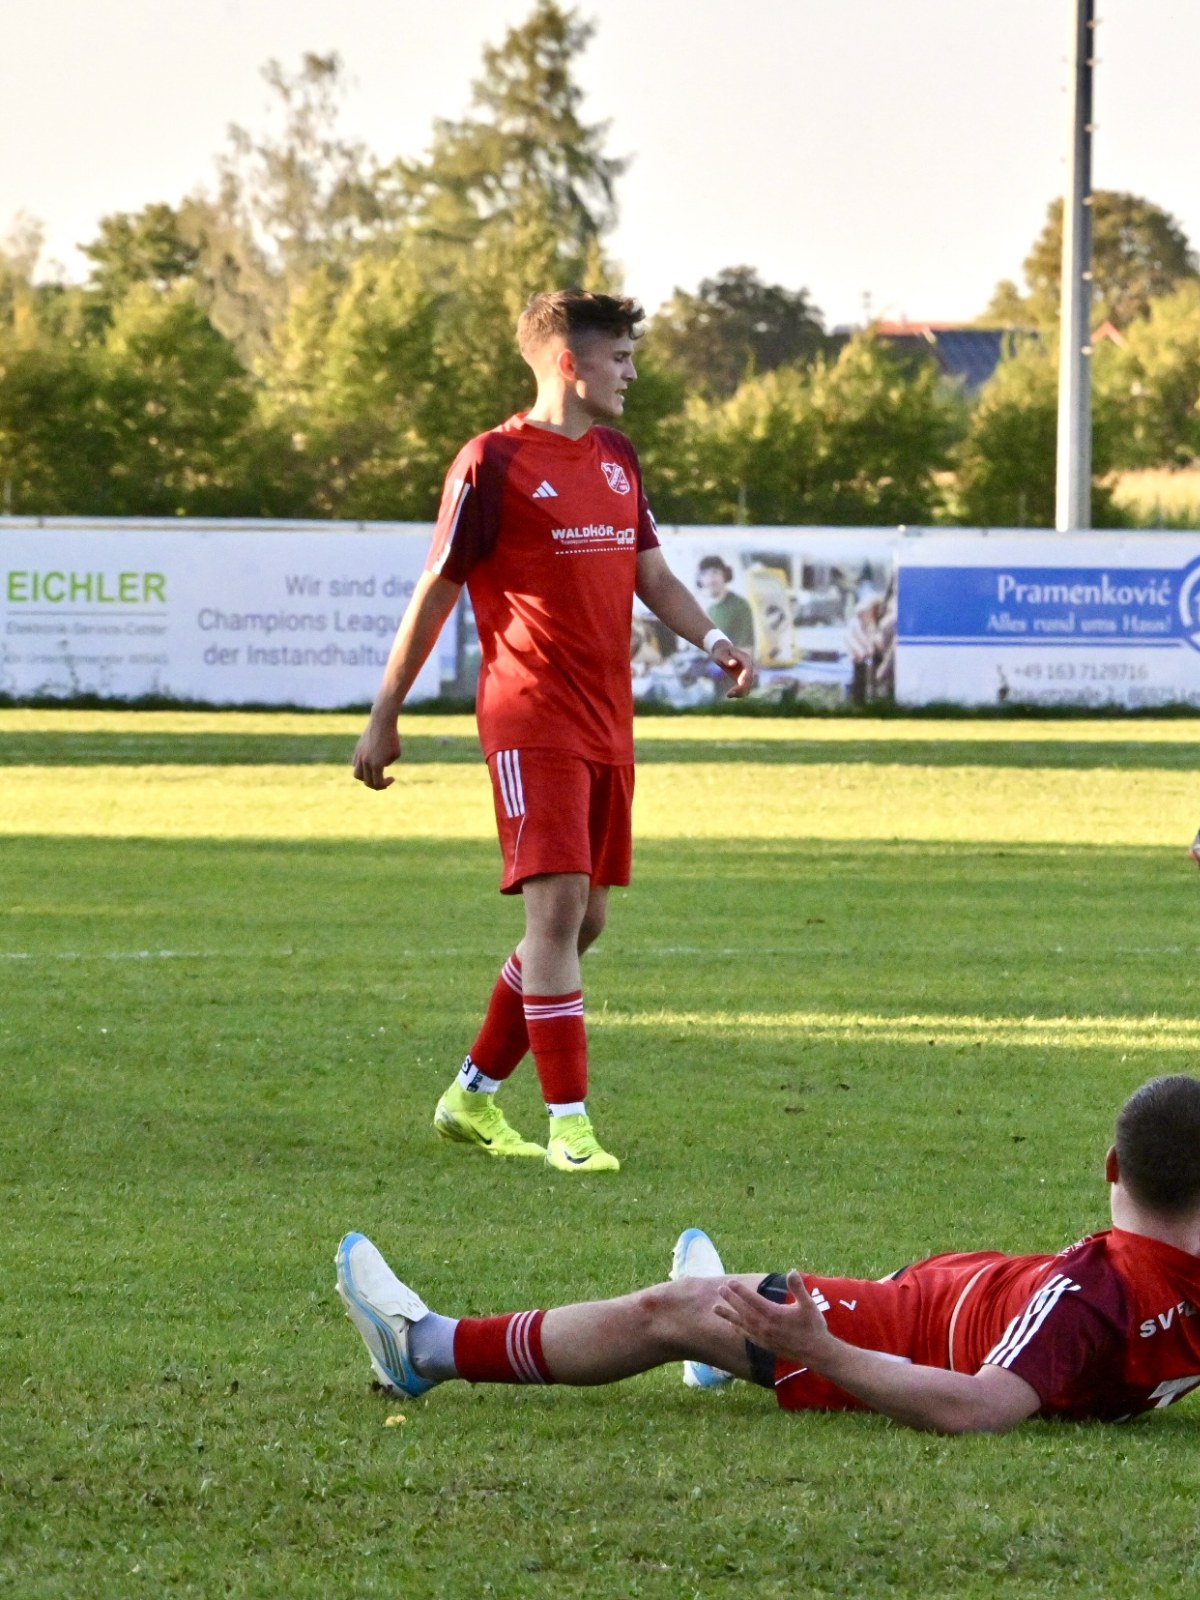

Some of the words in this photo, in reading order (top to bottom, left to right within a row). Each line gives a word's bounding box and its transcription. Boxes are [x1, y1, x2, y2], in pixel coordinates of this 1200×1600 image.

[7, 571, 167, 603] EICHLER
[286, 575, 320, 597] Wir
[329, 575, 376, 597] sind
[383, 576, 415, 597] die
[997, 573, 1171, 605] Pramenković
[197, 607, 328, 636] Champions
[333, 610, 402, 637] Leagu
[987, 612, 1027, 632] Alles
[1033, 611, 1075, 632] rund
[203, 643, 239, 665] der
[247, 643, 391, 666] Instandhaltu
